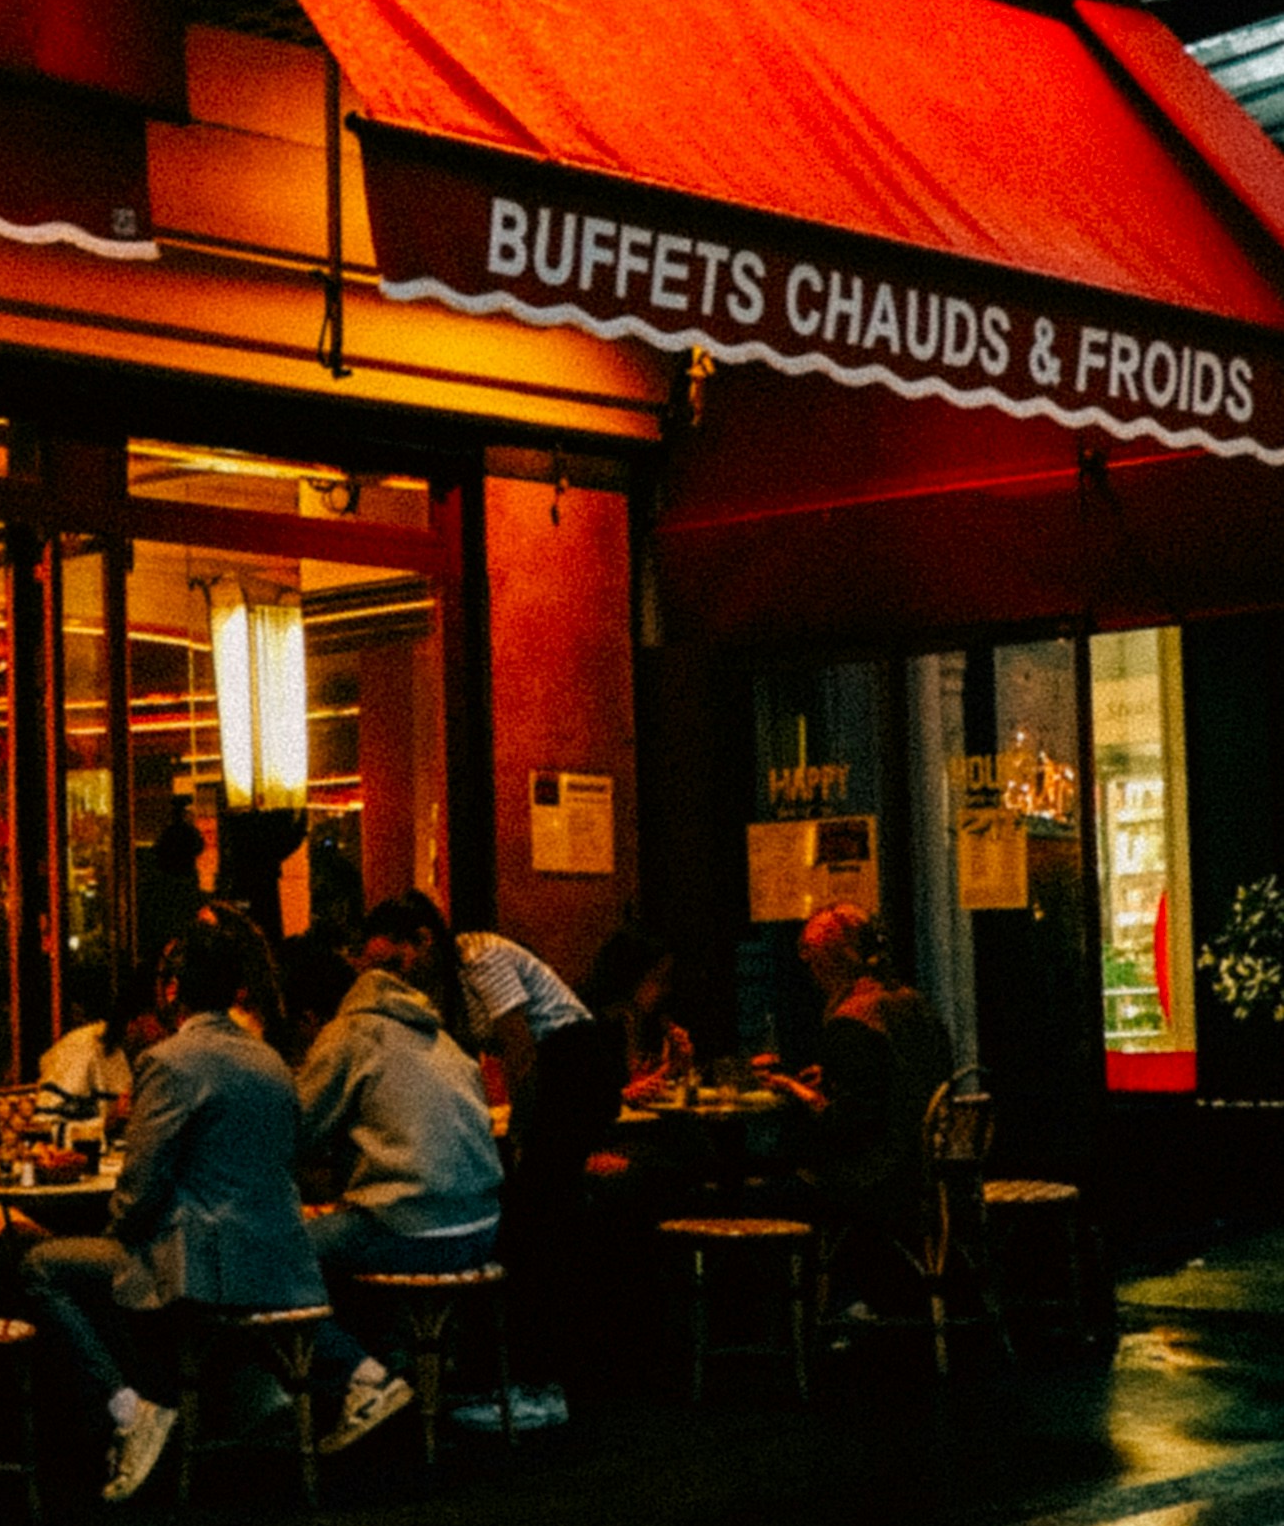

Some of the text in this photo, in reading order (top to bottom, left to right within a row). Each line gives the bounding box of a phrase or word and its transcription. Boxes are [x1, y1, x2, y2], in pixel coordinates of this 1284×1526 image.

[487, 198, 1255, 423] BUFFETS CHAUDS & FROIDS
[768, 760, 851, 805] HAPPY
